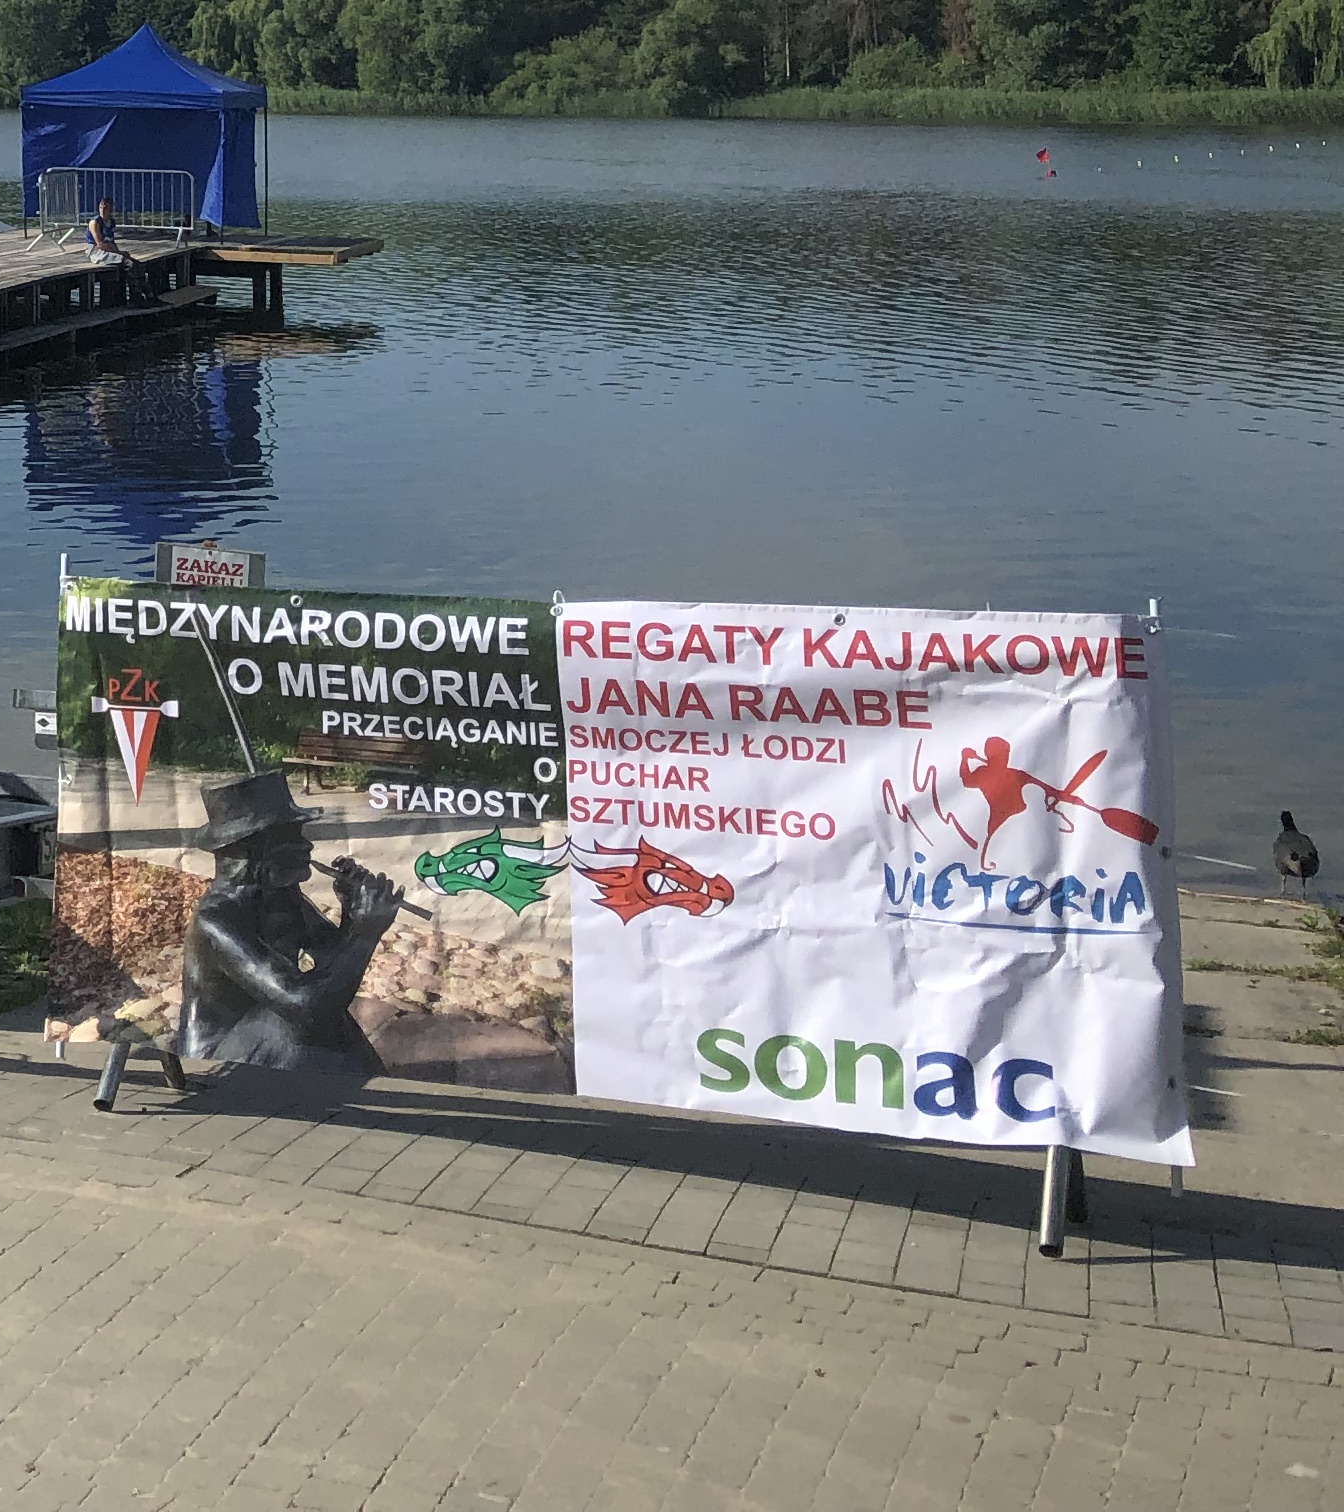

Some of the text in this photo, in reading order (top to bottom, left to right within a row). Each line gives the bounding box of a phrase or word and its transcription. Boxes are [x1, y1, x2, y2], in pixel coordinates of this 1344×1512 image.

[177, 558, 243, 576] ZAKAZ
[66, 595, 1149, 680] MIĘDZYNARODOWE REGATY KAJAKOWE
[109, 669, 159, 702] PZK
[229, 659, 933, 730] O MEMORIAŁ JANA RAABE
[322, 711, 847, 764] PRZECIĄGANIE SMOCZEJ ŁODZI
[534, 757, 711, 792] O PUCHAR
[369, 783, 836, 840] STAROSTY SZTUMSKIEGO
[696, 1027, 1057, 1122] sonac
